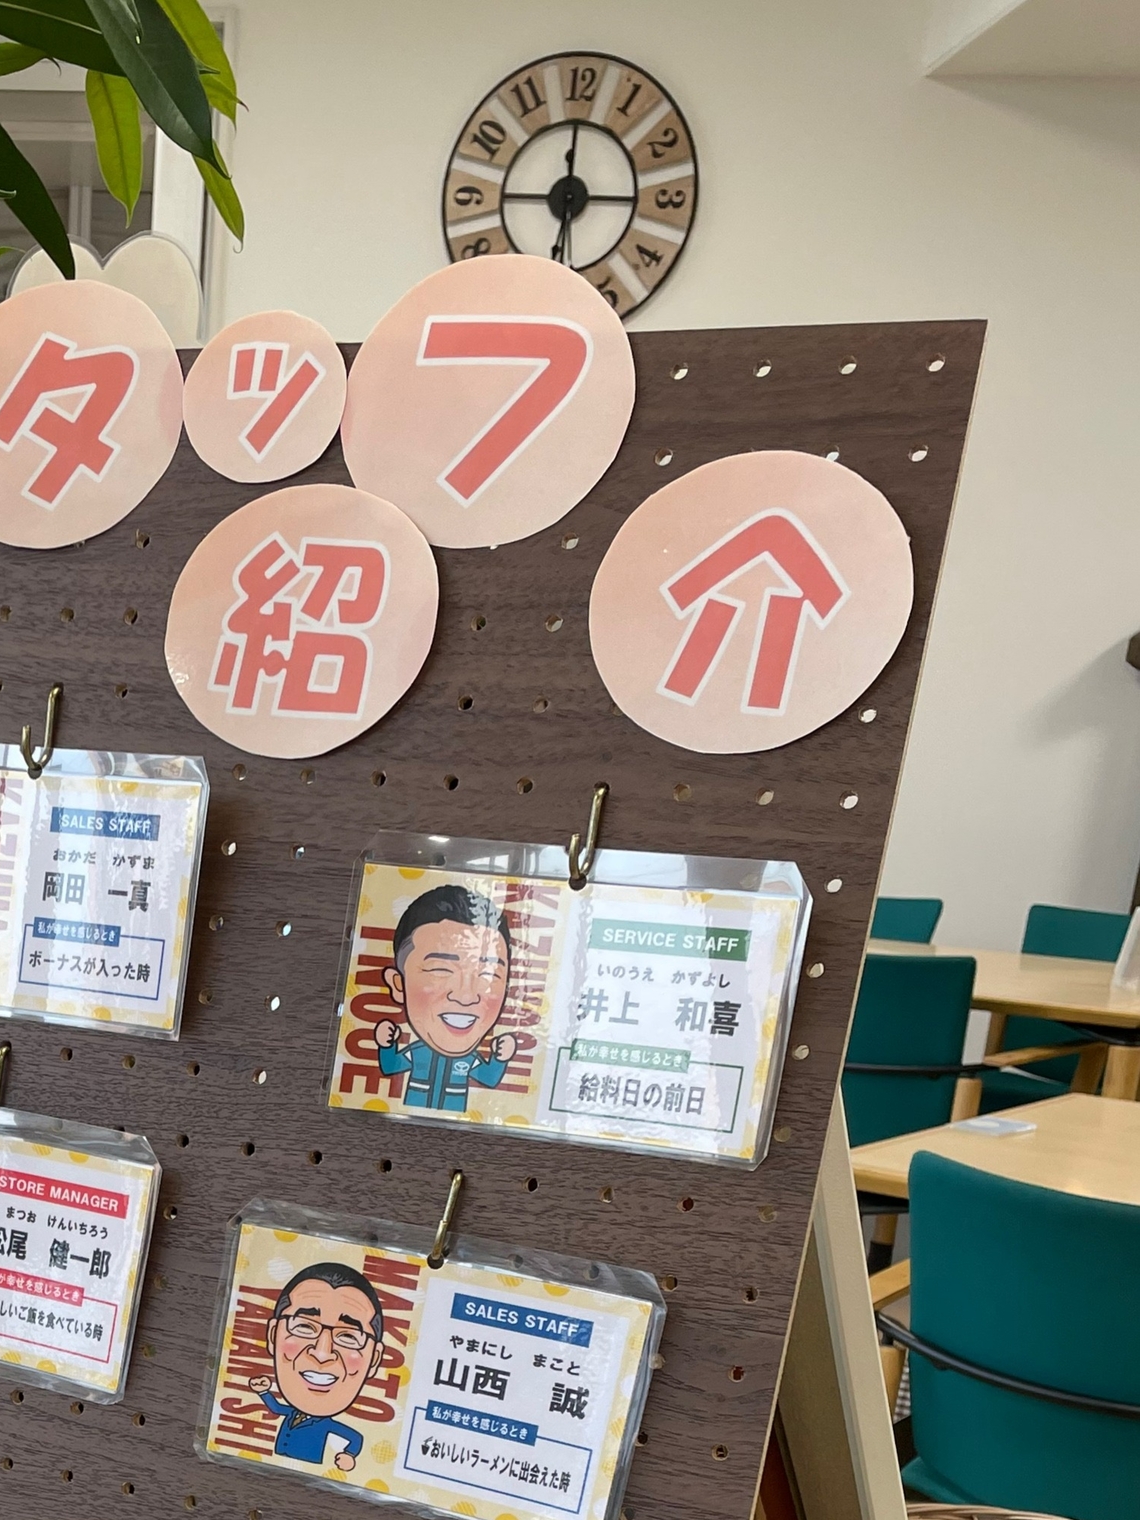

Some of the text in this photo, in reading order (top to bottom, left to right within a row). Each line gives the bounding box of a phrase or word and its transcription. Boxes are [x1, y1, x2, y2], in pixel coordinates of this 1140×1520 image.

[510, 76, 547, 117] 11
[565, 67, 596, 101] 12
[616, 83, 641, 117] 1
[471, 120, 507, 162] 10
[647, 128, 678, 158] 2
[454, 186, 484, 206] 9
[655, 189, 686, 209] 3
[636, 243, 664, 268] 4
[208, 507, 852, 721] 紹介
[61, 815, 151, 833] SALES STAFF
[53, 848, 155, 869] おかだ かずま
[42, 872, 151, 912] 岡田 一真
[602, 929, 739, 953] SERVICE STAFF
[29, 951, 151, 982] ボーナスが入った時
[597, 965, 731, 989] いのうえ かずよし
[576, 988, 742, 1037] 井上 和喜
[576, 1043, 684, 1068] 私が幸せを感じるとき
[578, 1073, 706, 1116] 給料日の前日
[49, 1185, 118, 1212] MANAGER
[6, 1206, 109, 1240] まつお けんいちろう
[49, 1237, 111, 1279] 健一郎
[464, 1302, 580, 1337] SALES STAFF
[449, 1334, 581, 1377] やまにし まこと
[433, 1358, 590, 1421] 山西 誠
[432, 1406, 529, 1439] 私が幸せを感じるとき
[429, 1438, 571, 1494] おいしいラーメンに出会えた時
